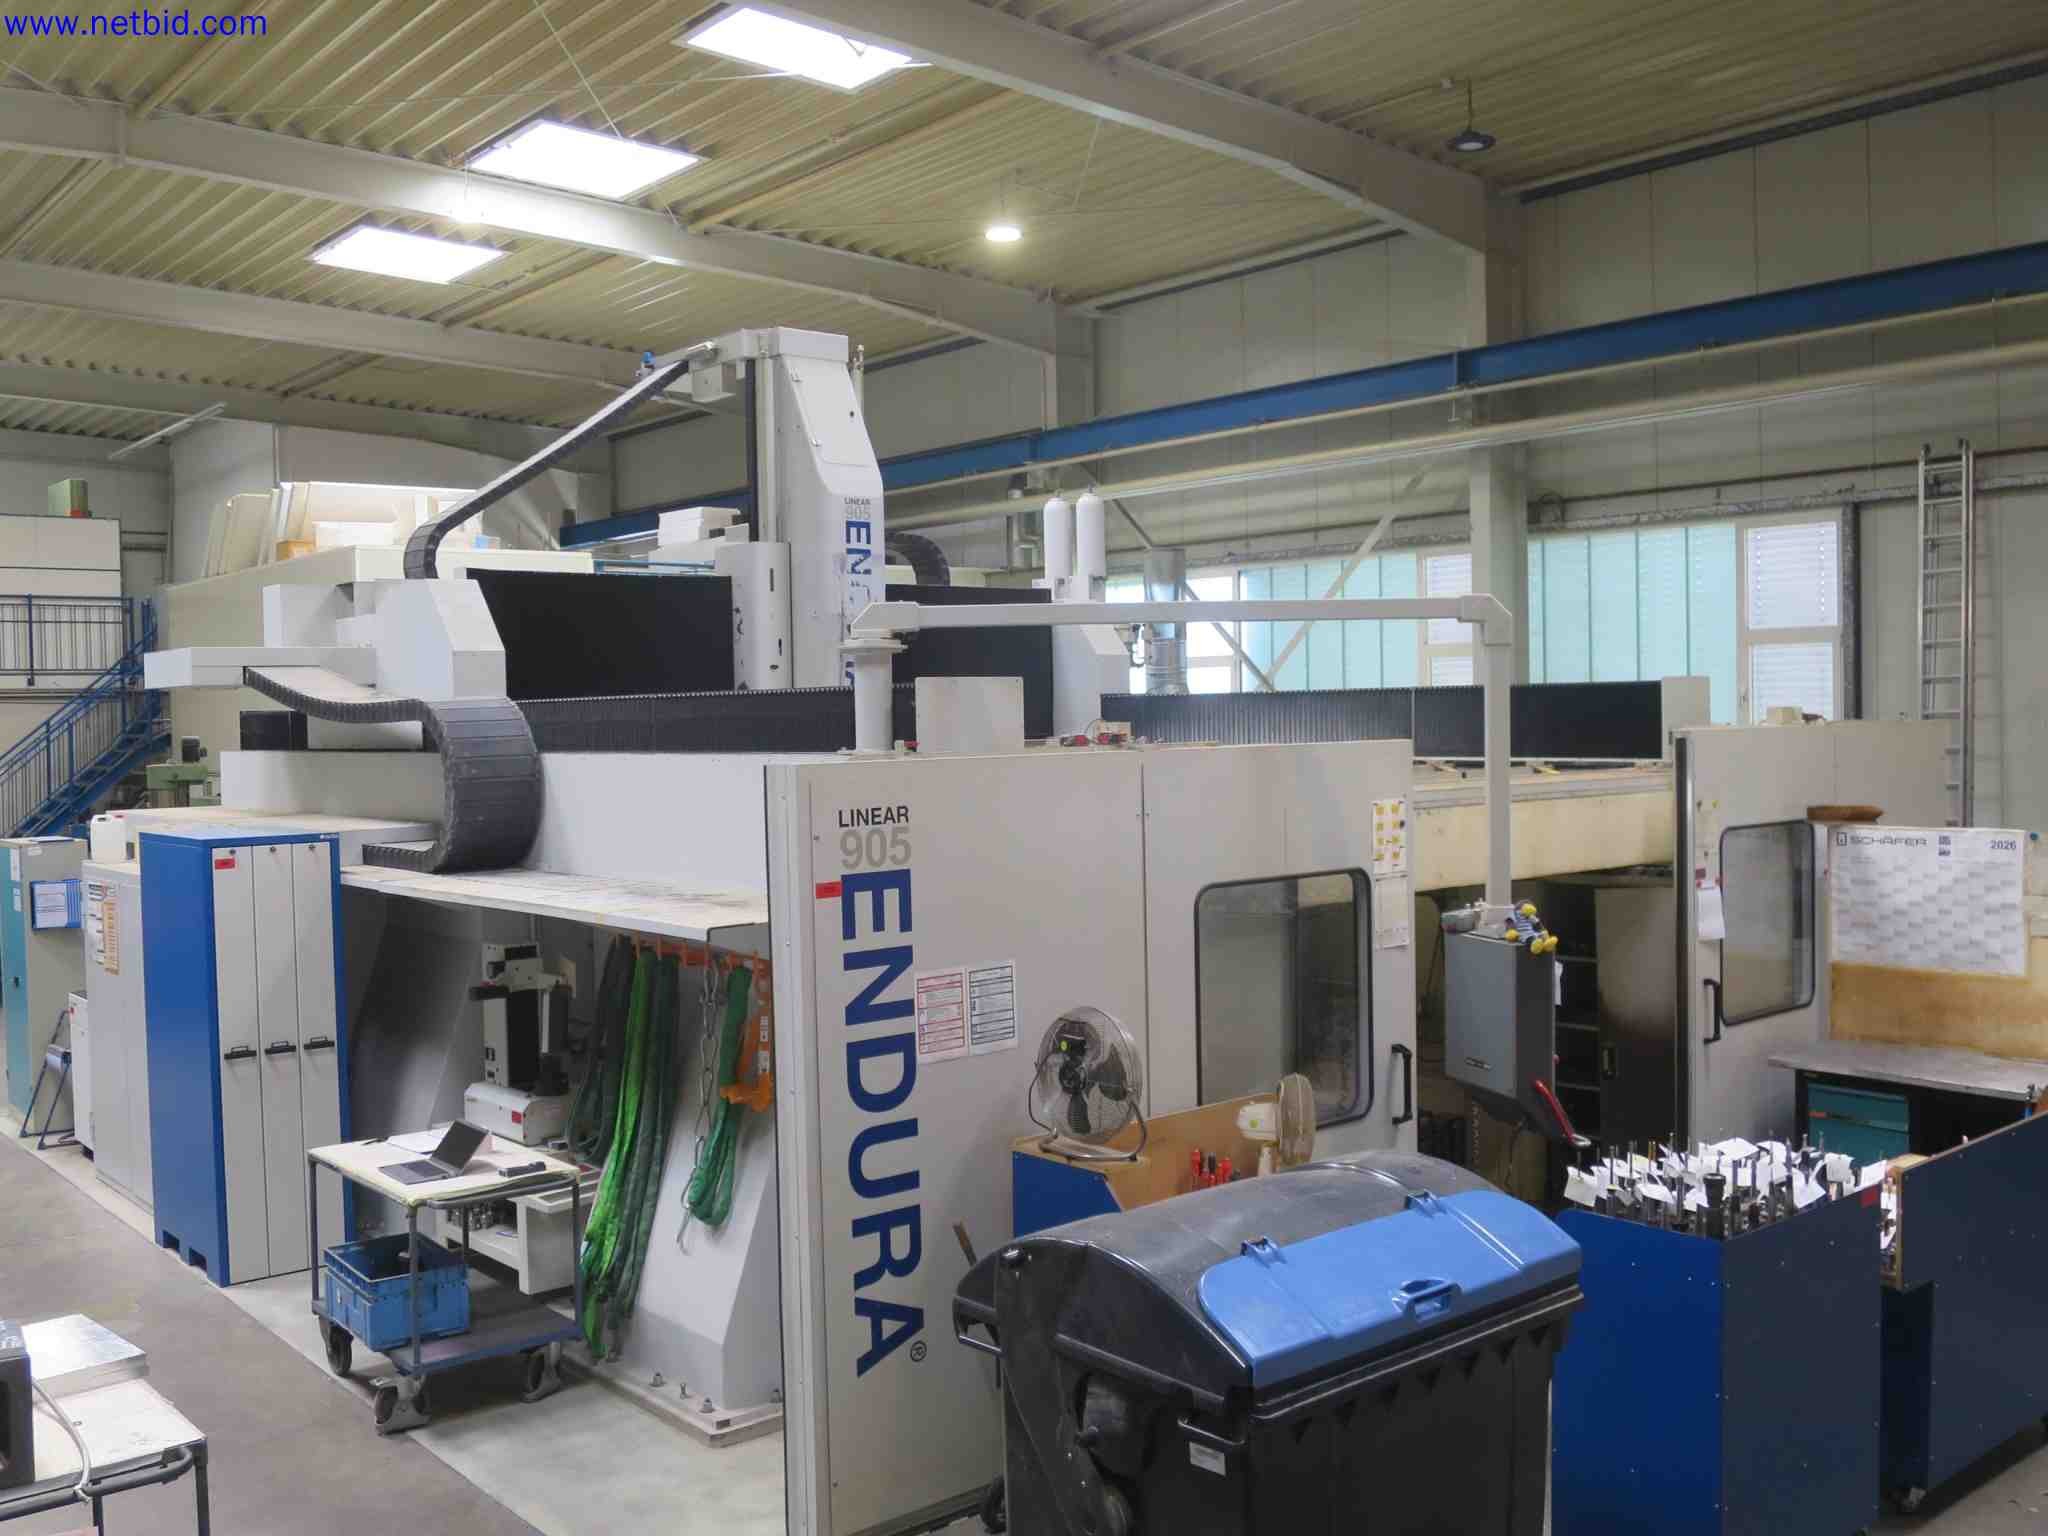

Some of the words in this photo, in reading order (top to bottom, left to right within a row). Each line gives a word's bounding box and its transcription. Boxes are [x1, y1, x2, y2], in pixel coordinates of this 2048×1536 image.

[838, 805, 910, 828] LINEAR
[839, 826, 912, 870] 905
[1990, 839, 2017, 850] 2026
